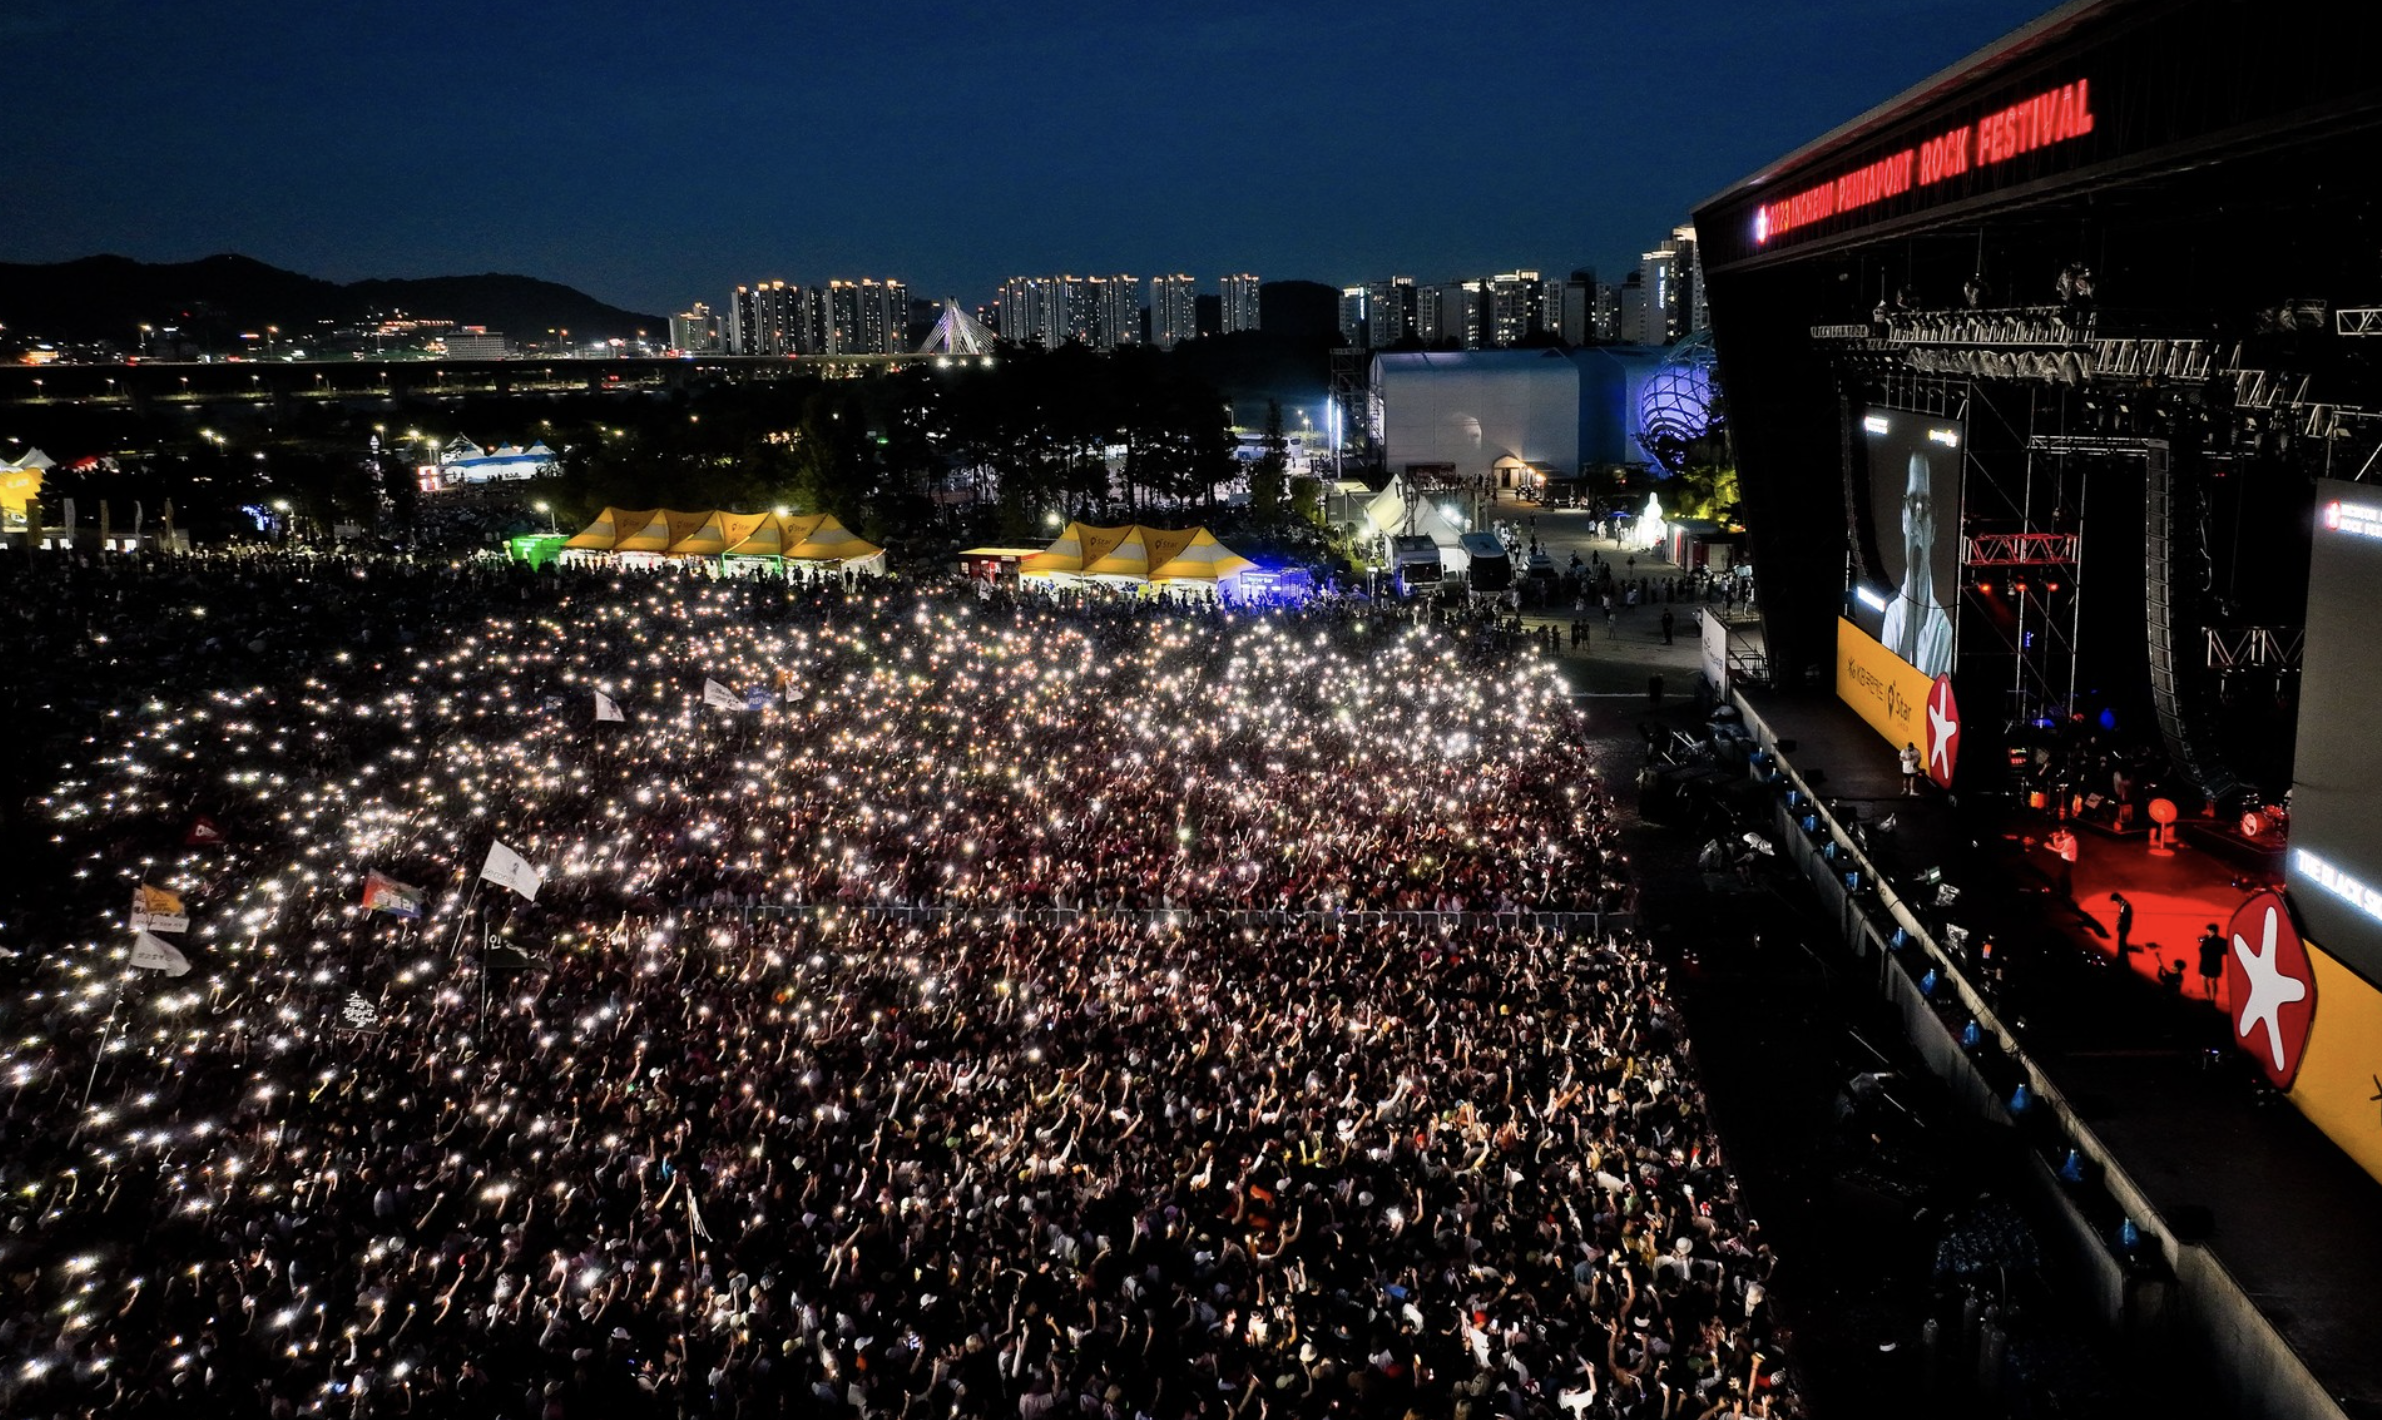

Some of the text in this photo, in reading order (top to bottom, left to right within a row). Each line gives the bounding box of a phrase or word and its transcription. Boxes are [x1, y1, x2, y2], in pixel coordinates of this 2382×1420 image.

[1791, 181, 1834, 228] INCHEON
[1838, 148, 1913, 213] PENTAPORT
[1919, 125, 1969, 186] ROCK
[1977, 77, 2094, 167] FESTIVAL
[1895, 691, 1912, 723] Star
[2297, 848, 2322, 882] THE
[2321, 862, 2364, 908] BLACK
